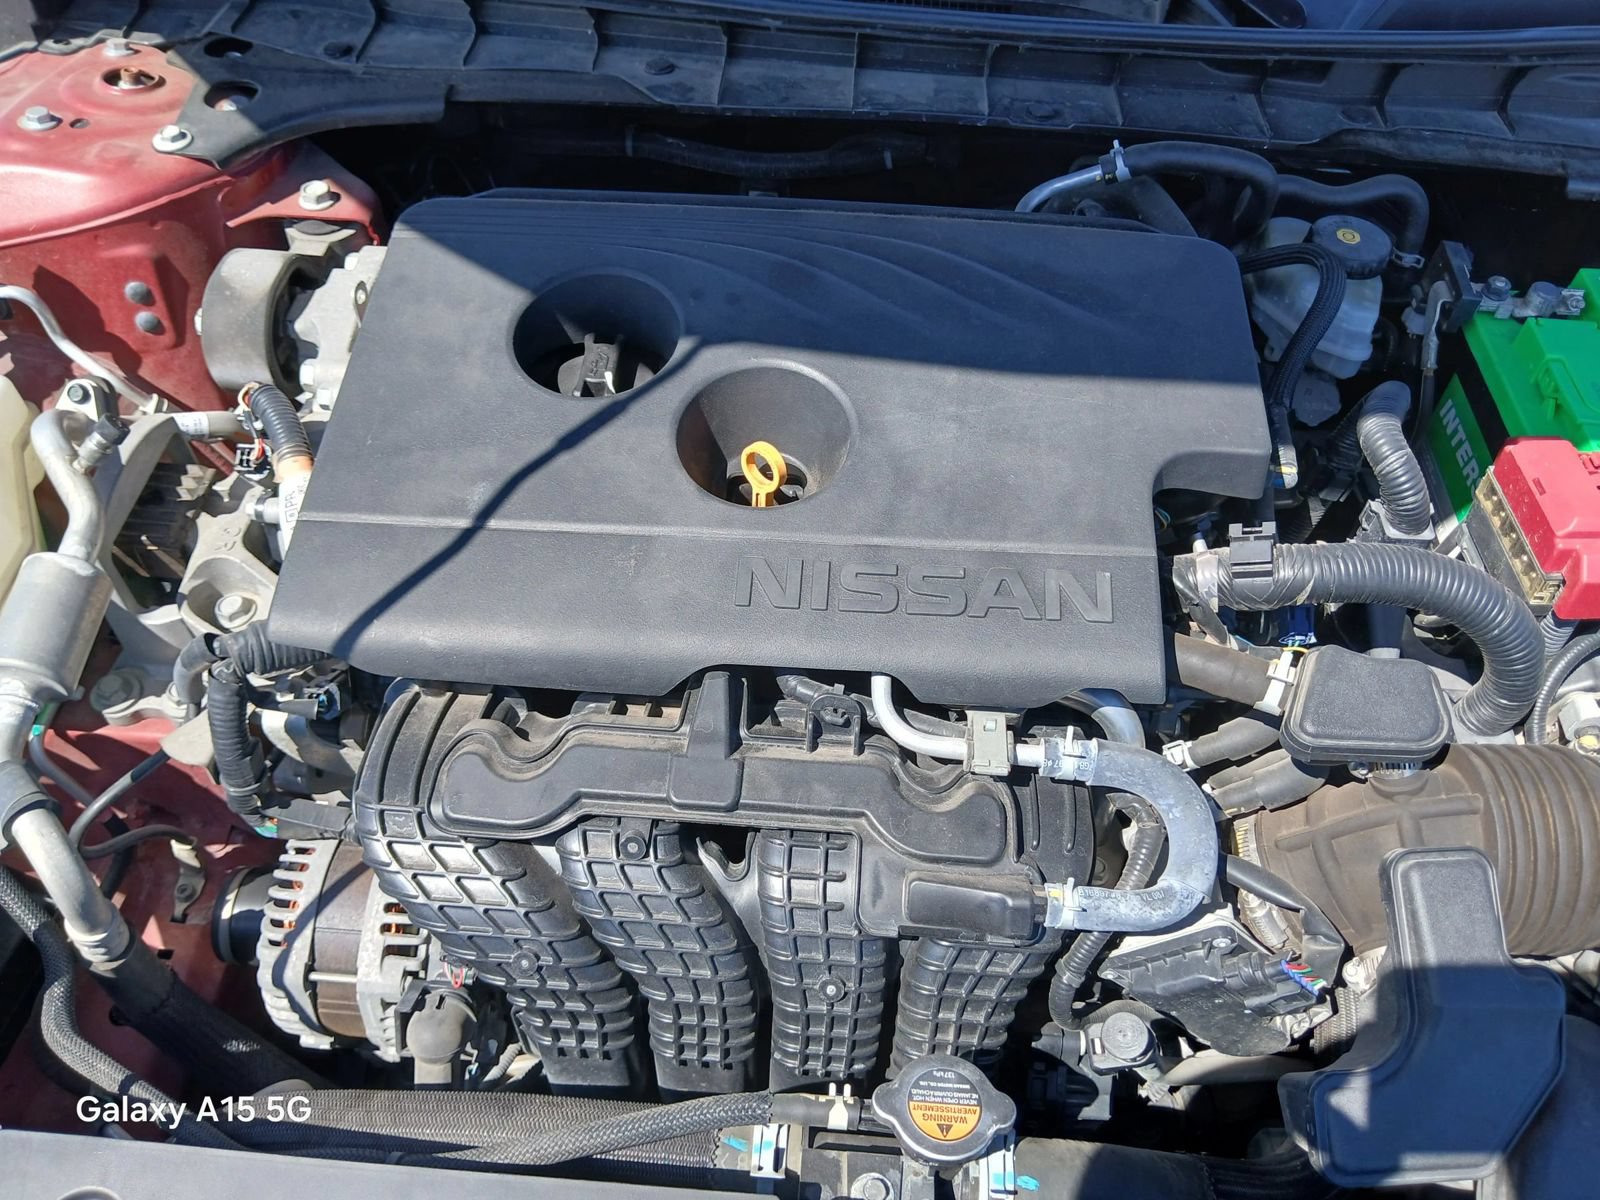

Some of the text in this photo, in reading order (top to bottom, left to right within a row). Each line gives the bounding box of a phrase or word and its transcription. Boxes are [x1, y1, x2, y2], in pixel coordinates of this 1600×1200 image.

[734, 555, 1114, 624] NISSAN
[912, 1104, 978, 1115] AVERTISSEMENT
[922, 1113, 968, 1124] WARNING
